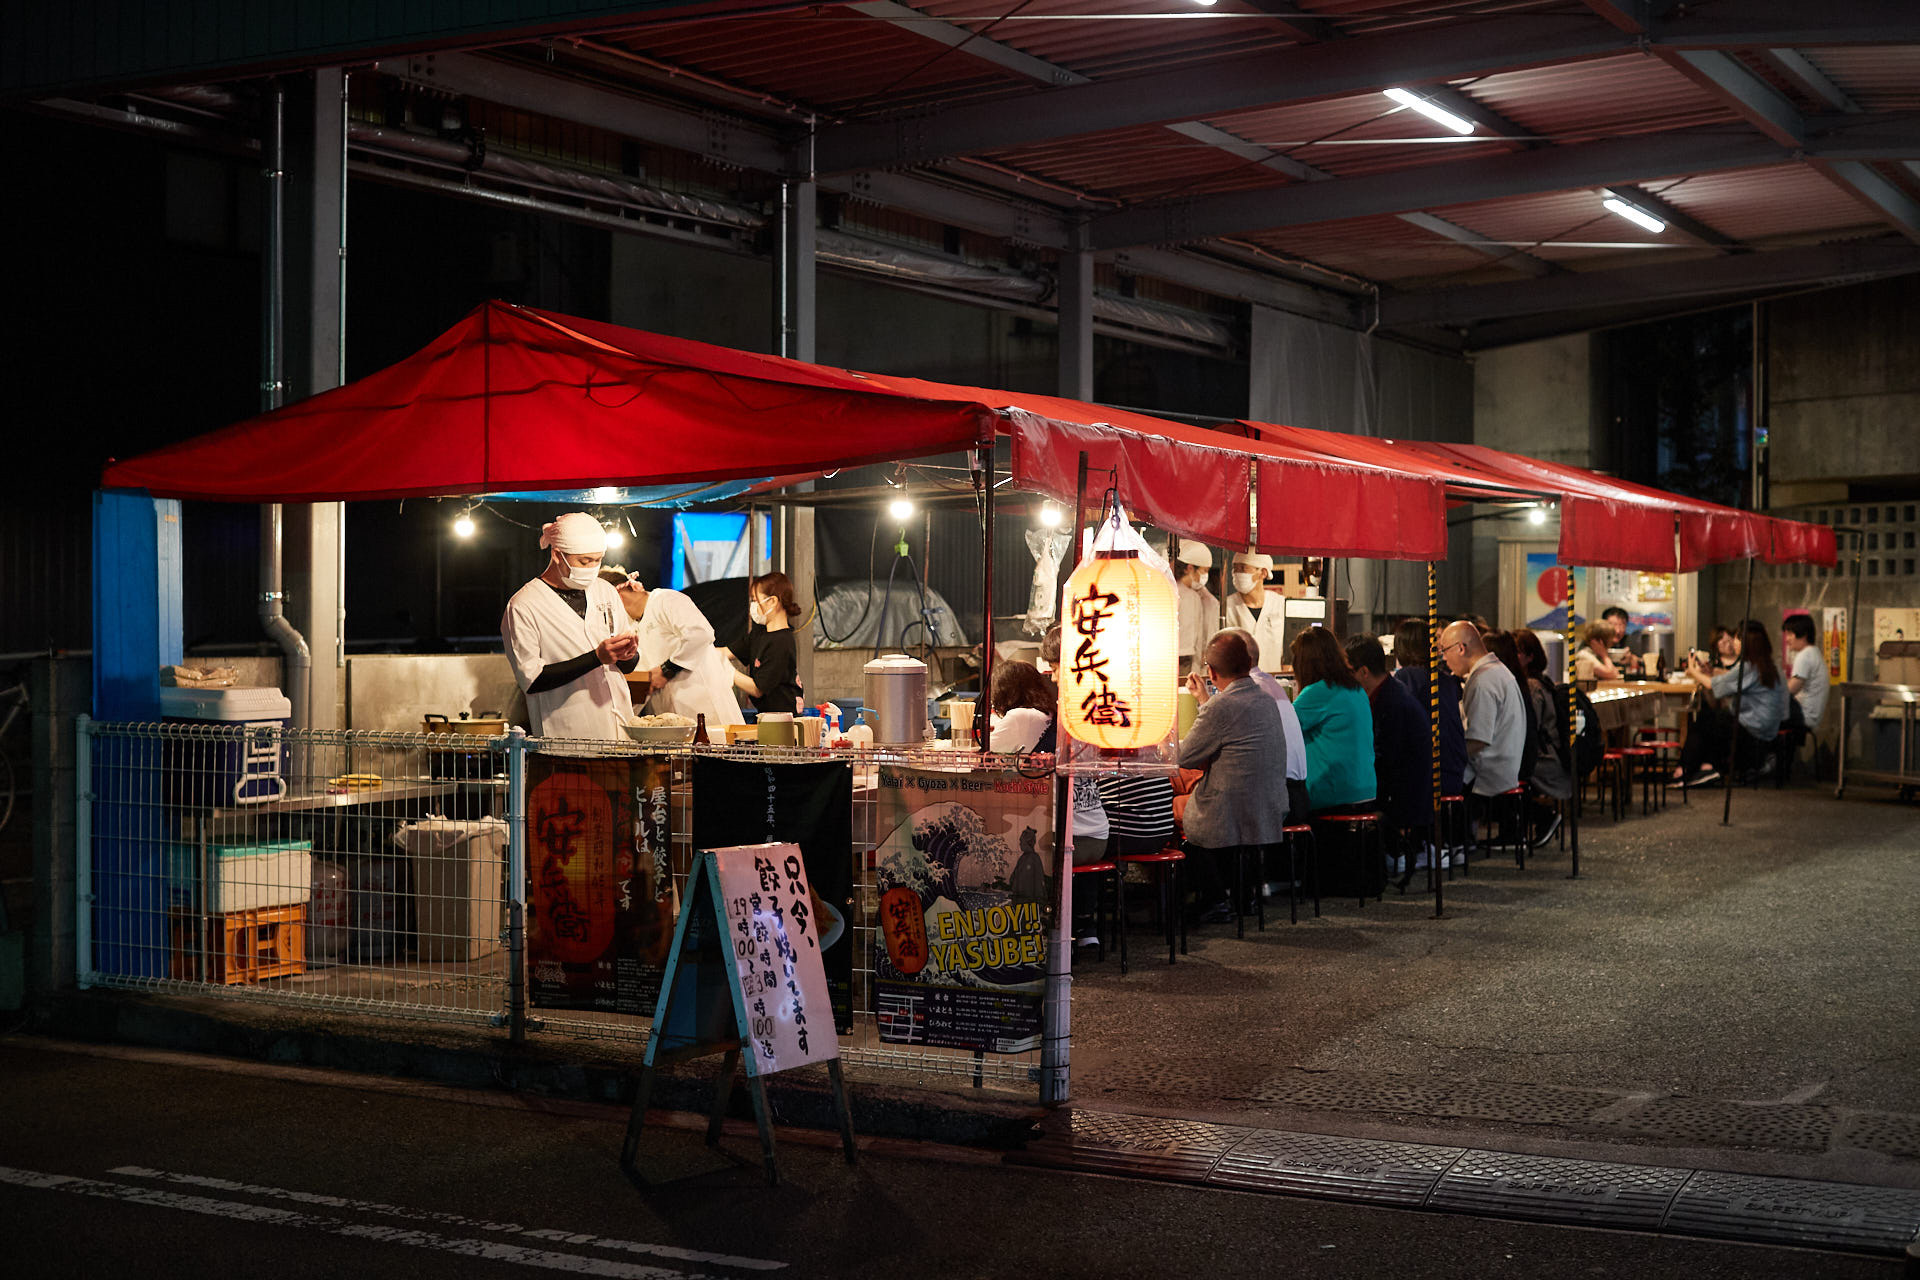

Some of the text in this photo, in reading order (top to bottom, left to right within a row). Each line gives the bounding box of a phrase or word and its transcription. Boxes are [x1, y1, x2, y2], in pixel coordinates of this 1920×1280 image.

[1071, 583, 1131, 728] 安兵衛
[634, 785, 651, 854] ビールは
[918, 776, 947, 793] Gyoza
[961, 778, 984, 792] Beer
[994, 780, 1022, 793] Kochi
[1023, 782, 1050, 799] Style
[537, 796, 591, 943] 安兵衛
[650, 786, 668, 904] 屋台と餃子と
[754, 855, 809, 1056] 餃子焼いてます
[889, 898, 920, 957] 安兵衛
[931, 934, 1047, 974] YASUBE!
[937, 901, 1043, 943] ENJOY!!
